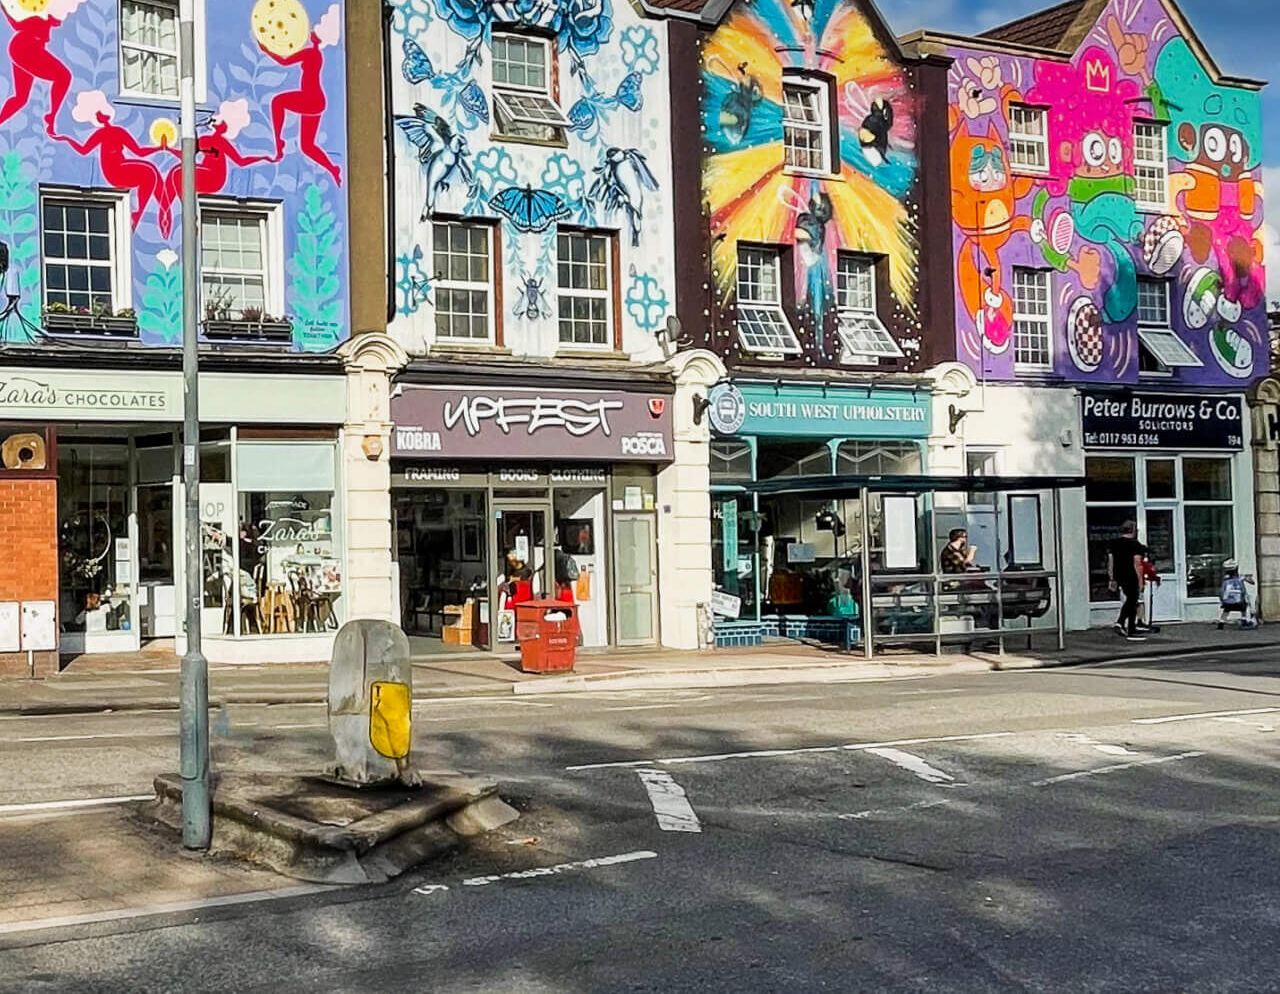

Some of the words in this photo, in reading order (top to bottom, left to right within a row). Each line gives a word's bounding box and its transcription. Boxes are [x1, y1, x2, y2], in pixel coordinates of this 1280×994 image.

[64, 392, 166, 408] CHOCOLATES
[442, 394, 624, 437] UPFEST
[748, 401, 798, 418] SOUTH
[801, 403, 839, 420] WEST
[843, 404, 927, 423] UPHOLSTERY
[1083, 396, 1128, 417] Peter
[1131, 398, 1196, 419] Burrows
[1199, 400, 1213, 420] &
[1215, 400, 1241, 421] Co.
[1138, 419, 1194, 432] SOLICITORS
[396, 431, 442, 451] KOBRA
[621, 436, 667, 455] POSCA
[1099, 432, 1120, 445] 0117
[404, 467, 460, 481] FRAMING
[500, 467, 539, 482] BOOKS
[550, 468, 606, 482] CLOTHING
